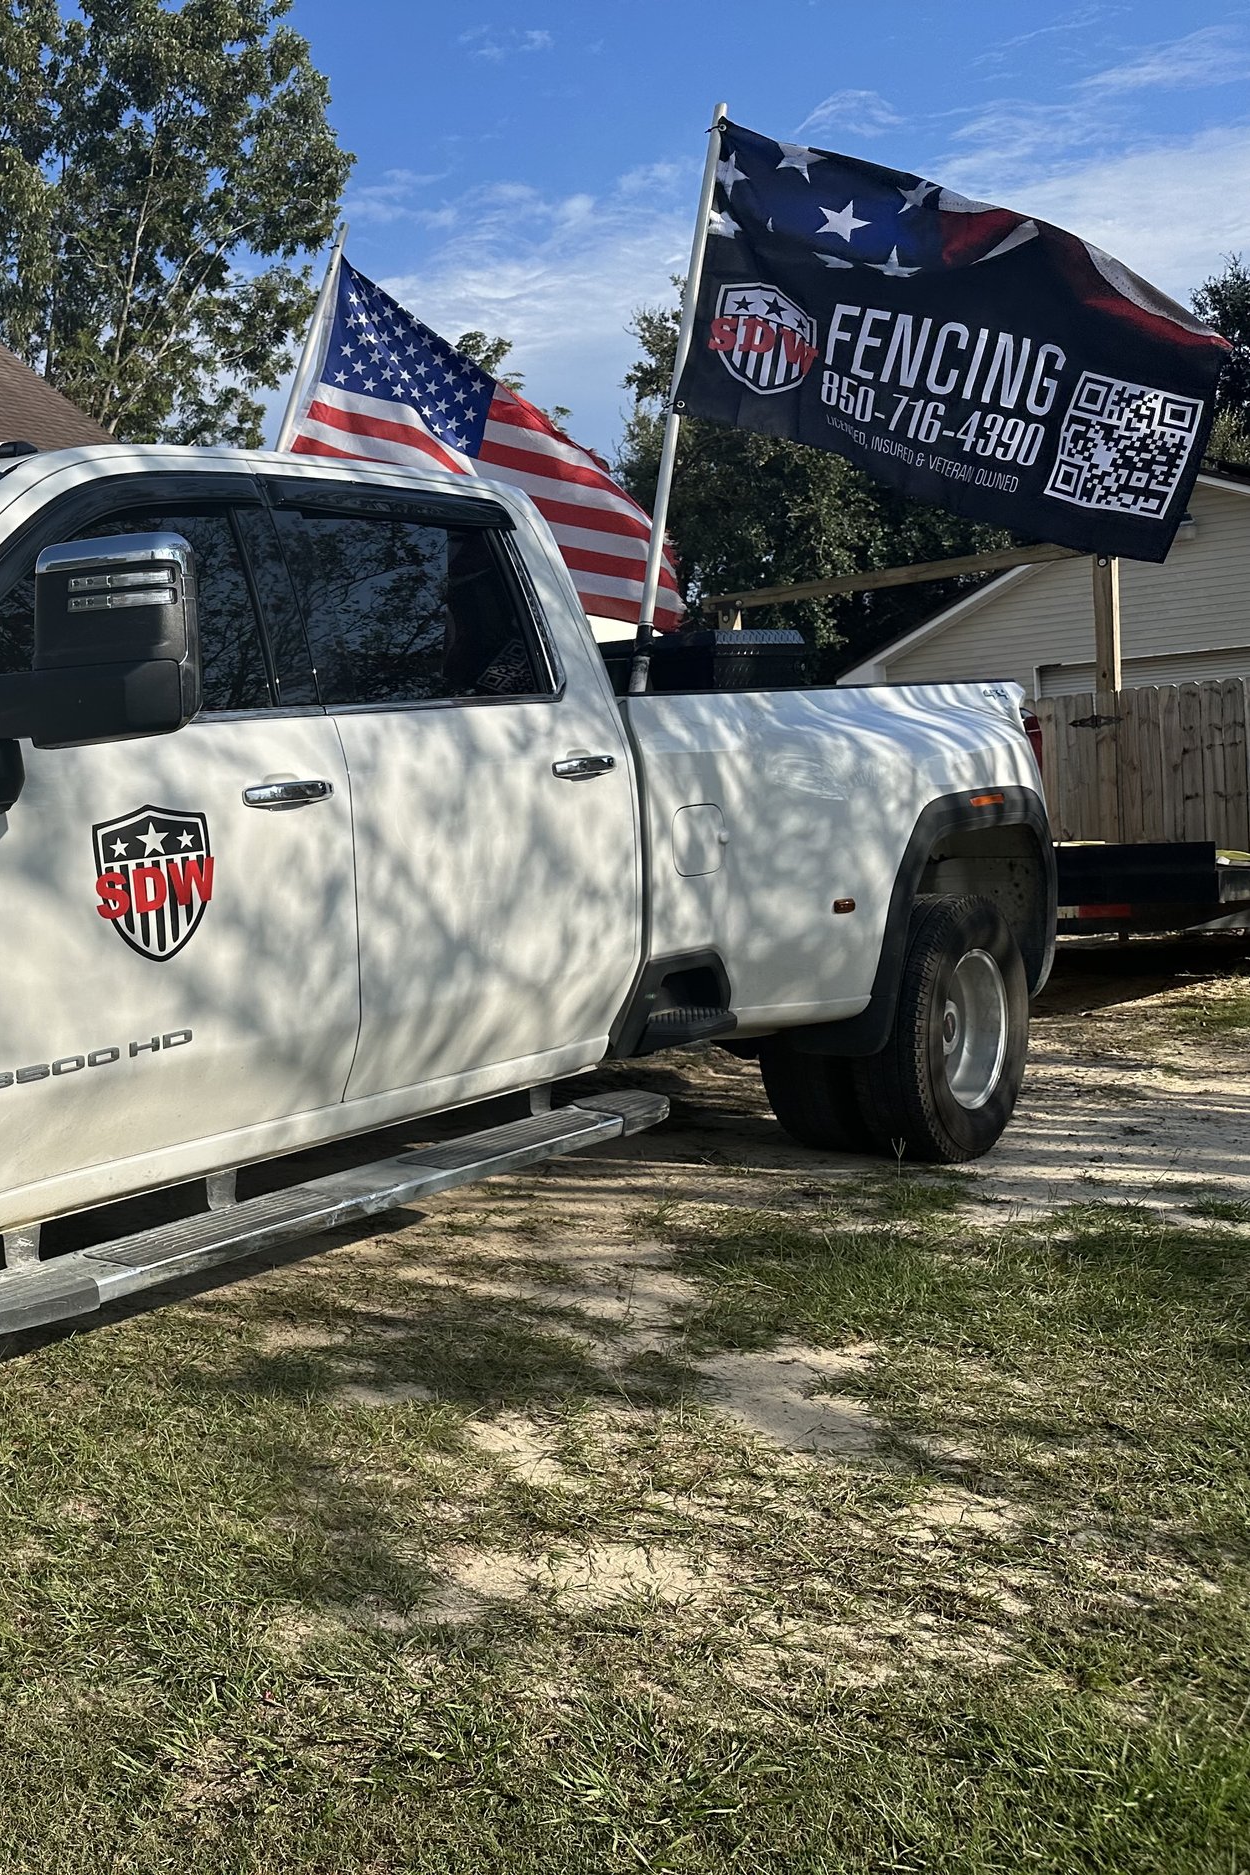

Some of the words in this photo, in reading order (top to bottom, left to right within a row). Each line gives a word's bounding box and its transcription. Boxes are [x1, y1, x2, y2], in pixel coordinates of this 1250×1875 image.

[708, 317, 819, 375] SDW
[824, 303, 1066, 416] FENCING
[821, 370, 1045, 466] 850-716-4390
[871, 436, 913, 464] INSURED
[915, 452, 925, 467] &
[928, 454, 976, 484] VETERAN
[974, 468, 1019, 493] OWNED
[95, 857, 214, 919] SDW
[129, 1029, 193, 1058] HD
